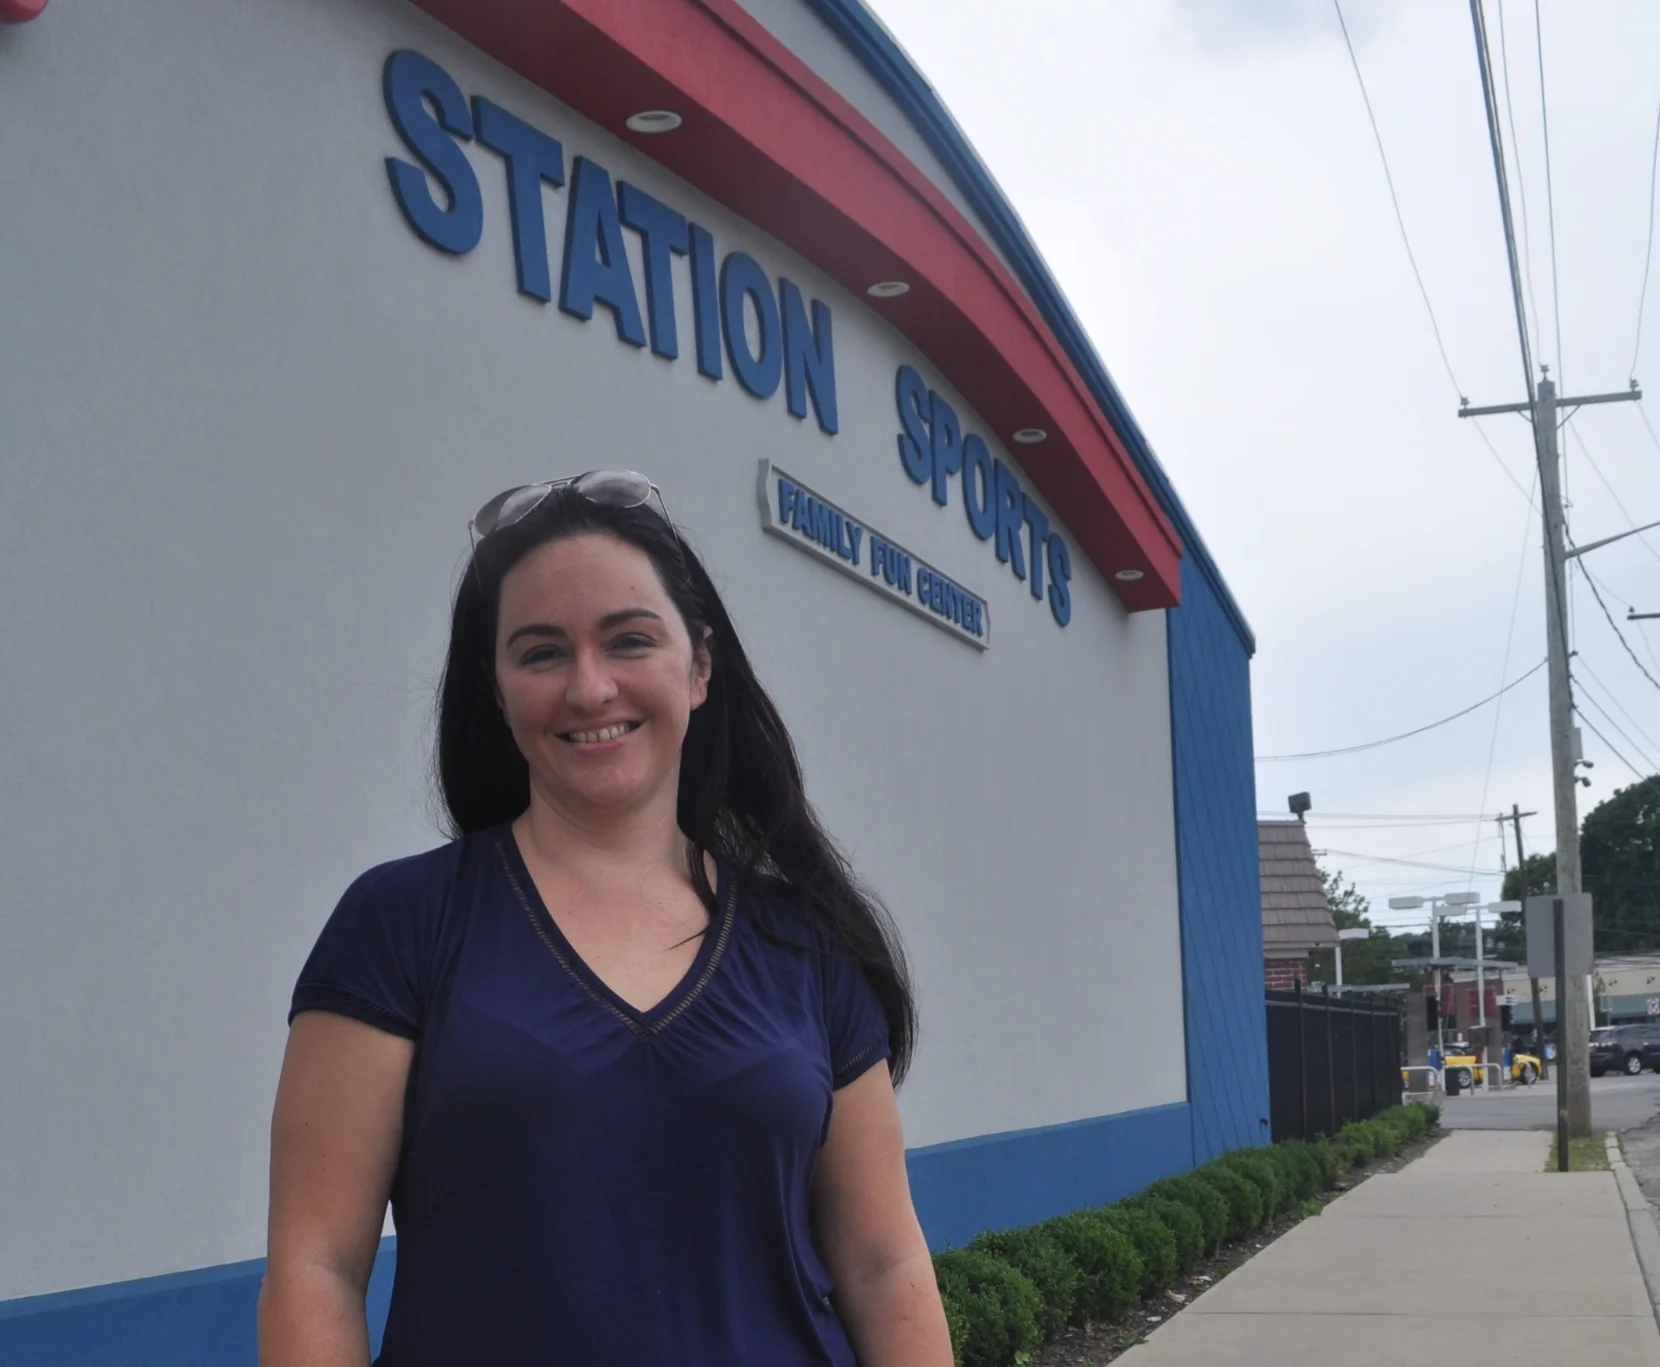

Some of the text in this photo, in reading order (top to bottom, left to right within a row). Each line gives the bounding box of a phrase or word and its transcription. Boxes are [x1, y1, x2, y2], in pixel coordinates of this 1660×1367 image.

[383, 49, 1072, 628] STATION SPORTS
[778, 479, 983, 637] FAMILY FUN CENTER
